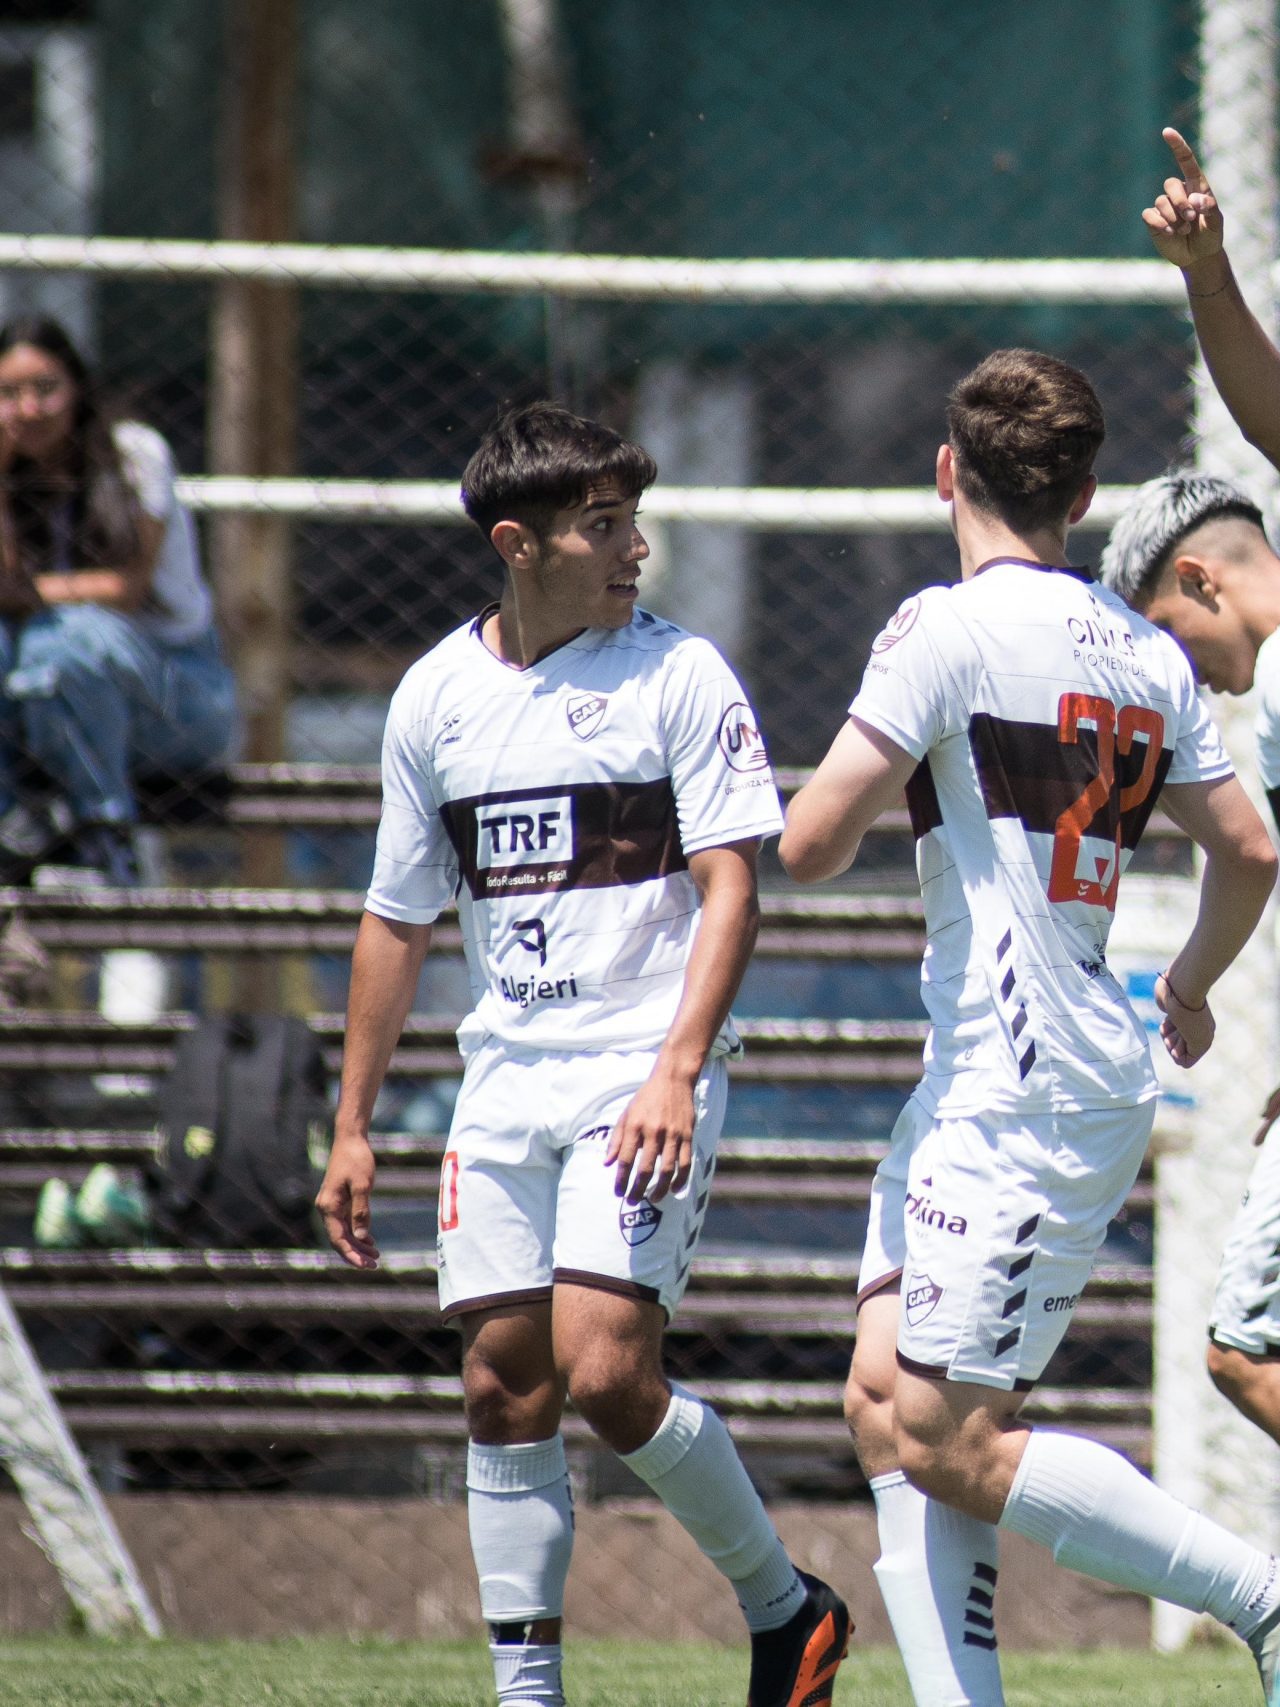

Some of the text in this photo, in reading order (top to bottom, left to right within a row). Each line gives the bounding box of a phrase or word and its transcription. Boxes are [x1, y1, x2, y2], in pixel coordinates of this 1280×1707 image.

[571, 700, 602, 725] CAP
[480, 811, 561, 854] TRF
[501, 872, 537, 886] Resulta
[547, 869, 568, 883] Fácil
[500, 971, 578, 1009] Algieri
[623, 1210, 655, 1227] CAP
[907, 1287, 934, 1308] CAP
